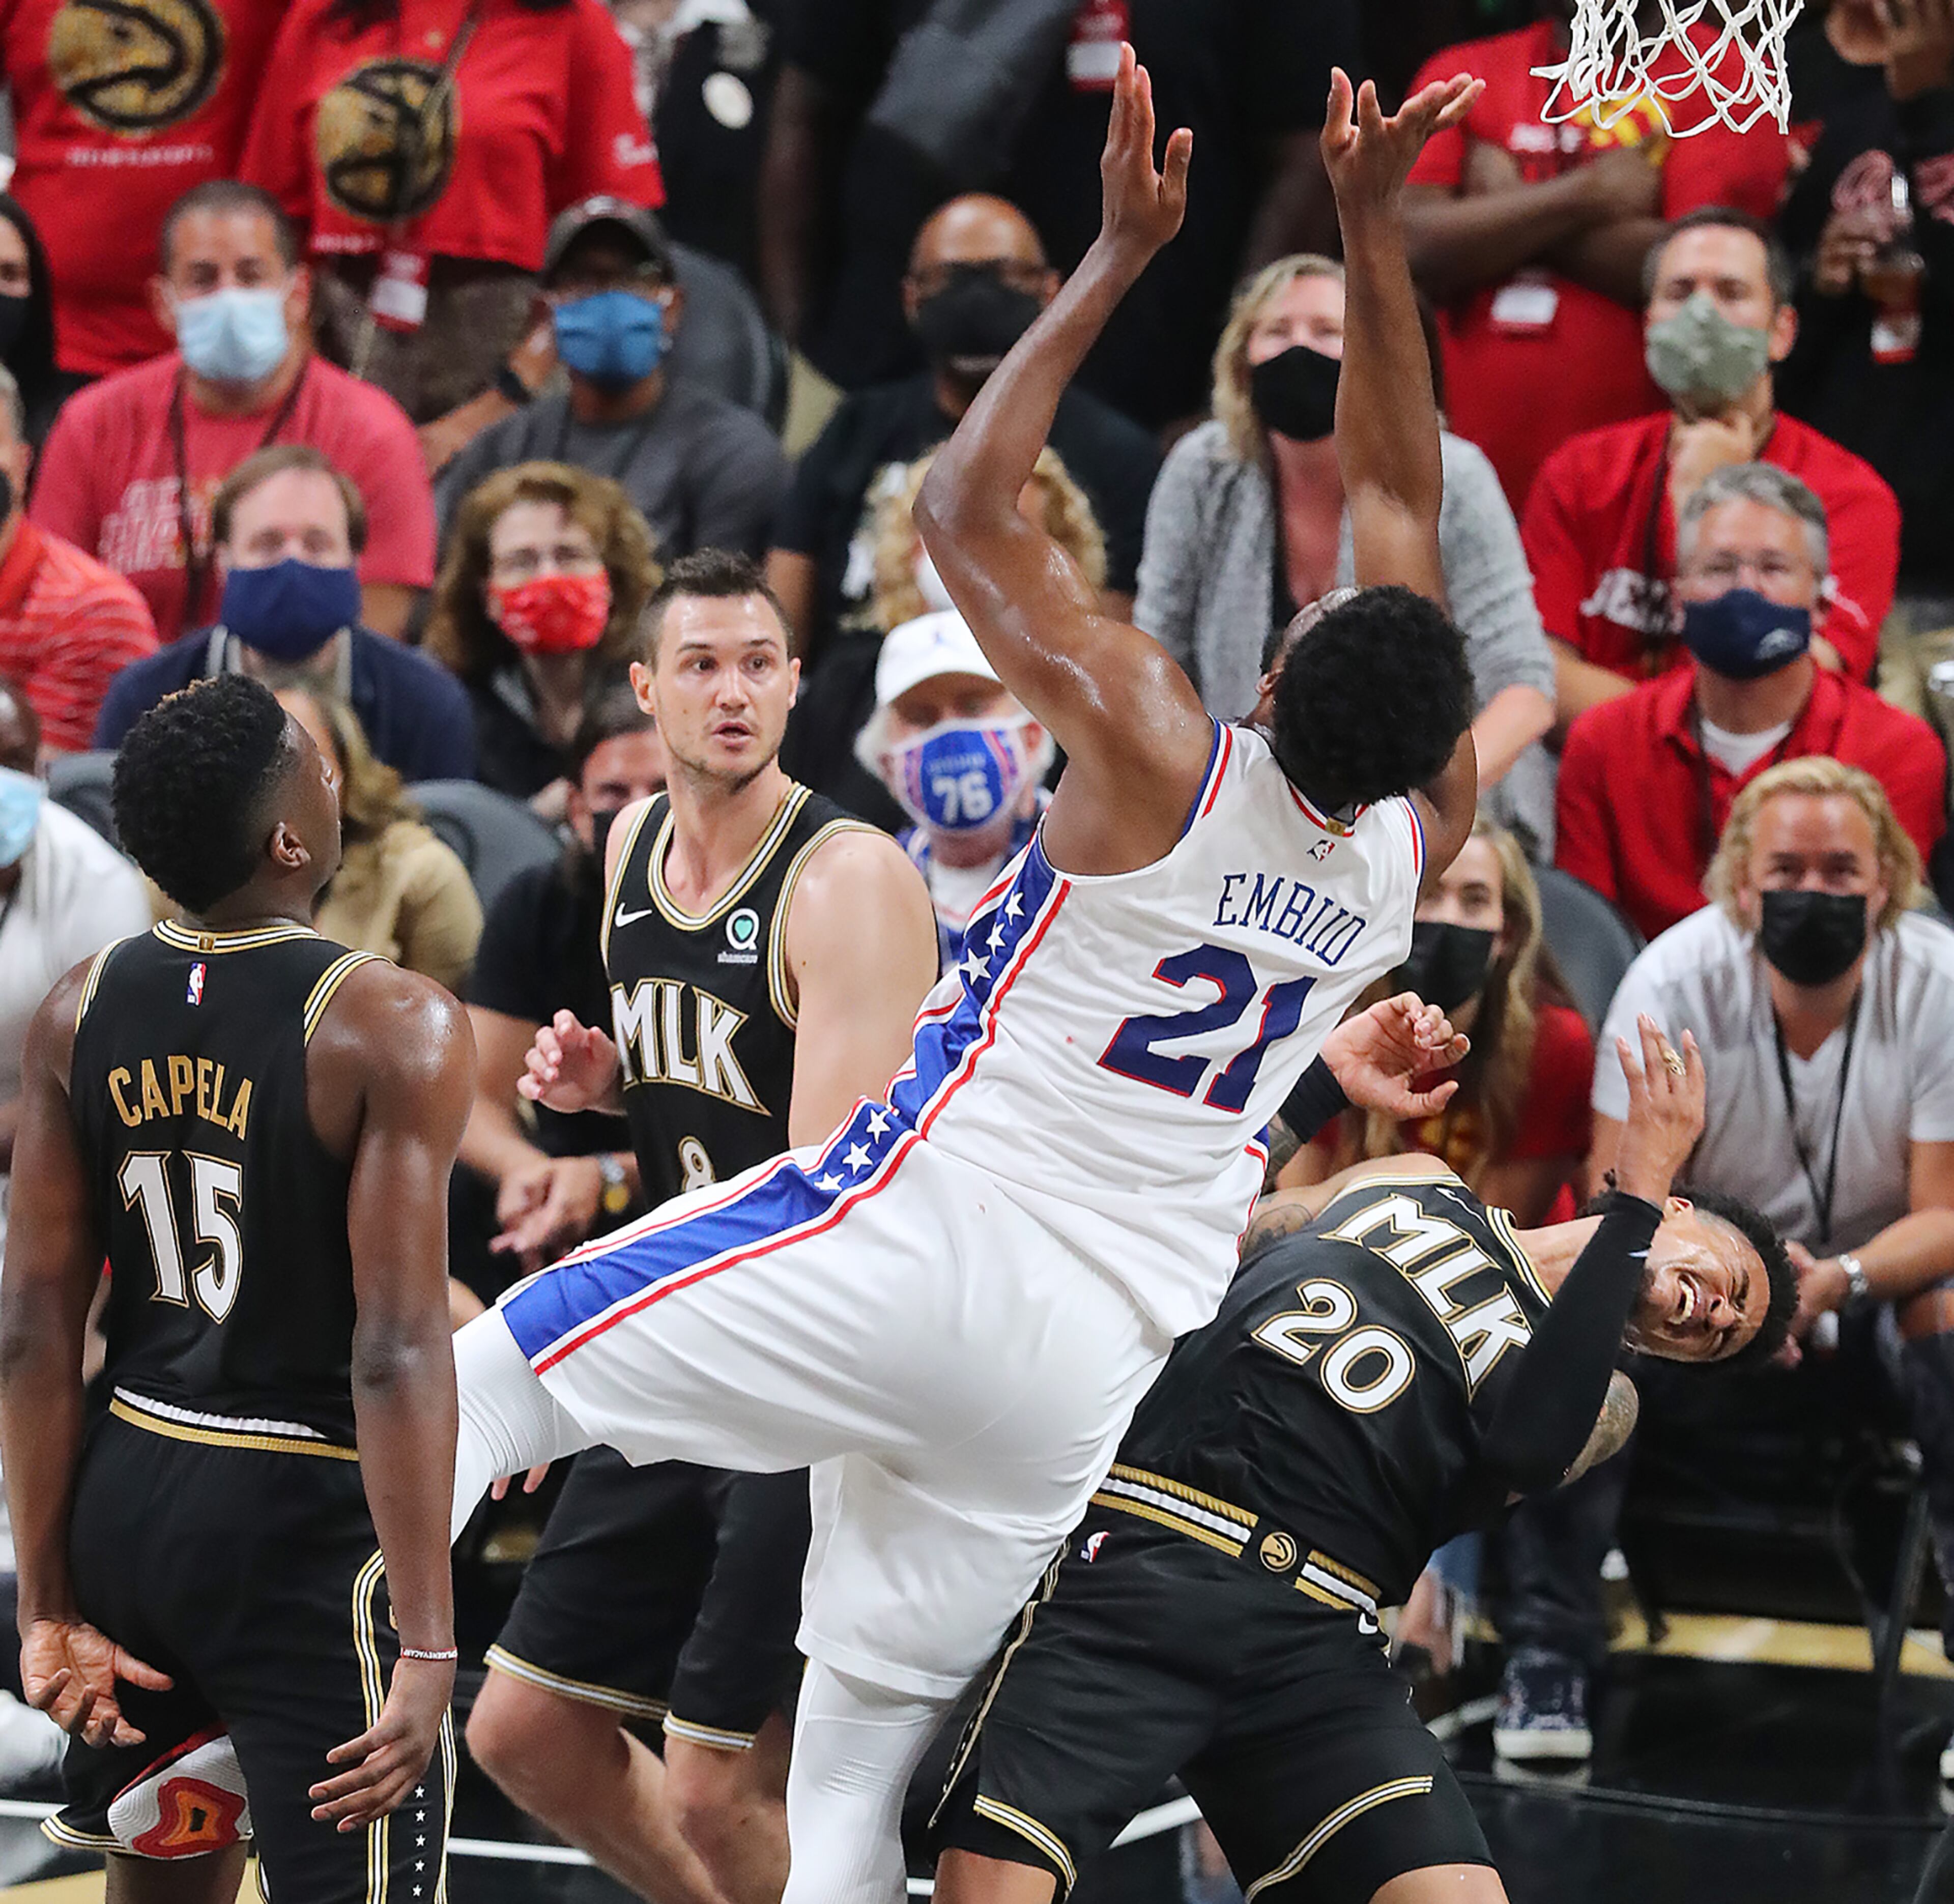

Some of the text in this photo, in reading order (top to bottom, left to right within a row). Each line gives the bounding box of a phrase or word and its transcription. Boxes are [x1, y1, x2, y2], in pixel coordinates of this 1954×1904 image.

[932, 771, 993, 824] 76
[1213, 873, 1366, 966] EMBIID
[610, 977, 772, 1116] MLK
[1096, 943, 1318, 1114] 21
[108, 1055, 253, 1141] CAPELA
[117, 1149, 243, 1324] 15
[1318, 1193, 1533, 1403] MLK
[1250, 1278, 1416, 1414] 20
